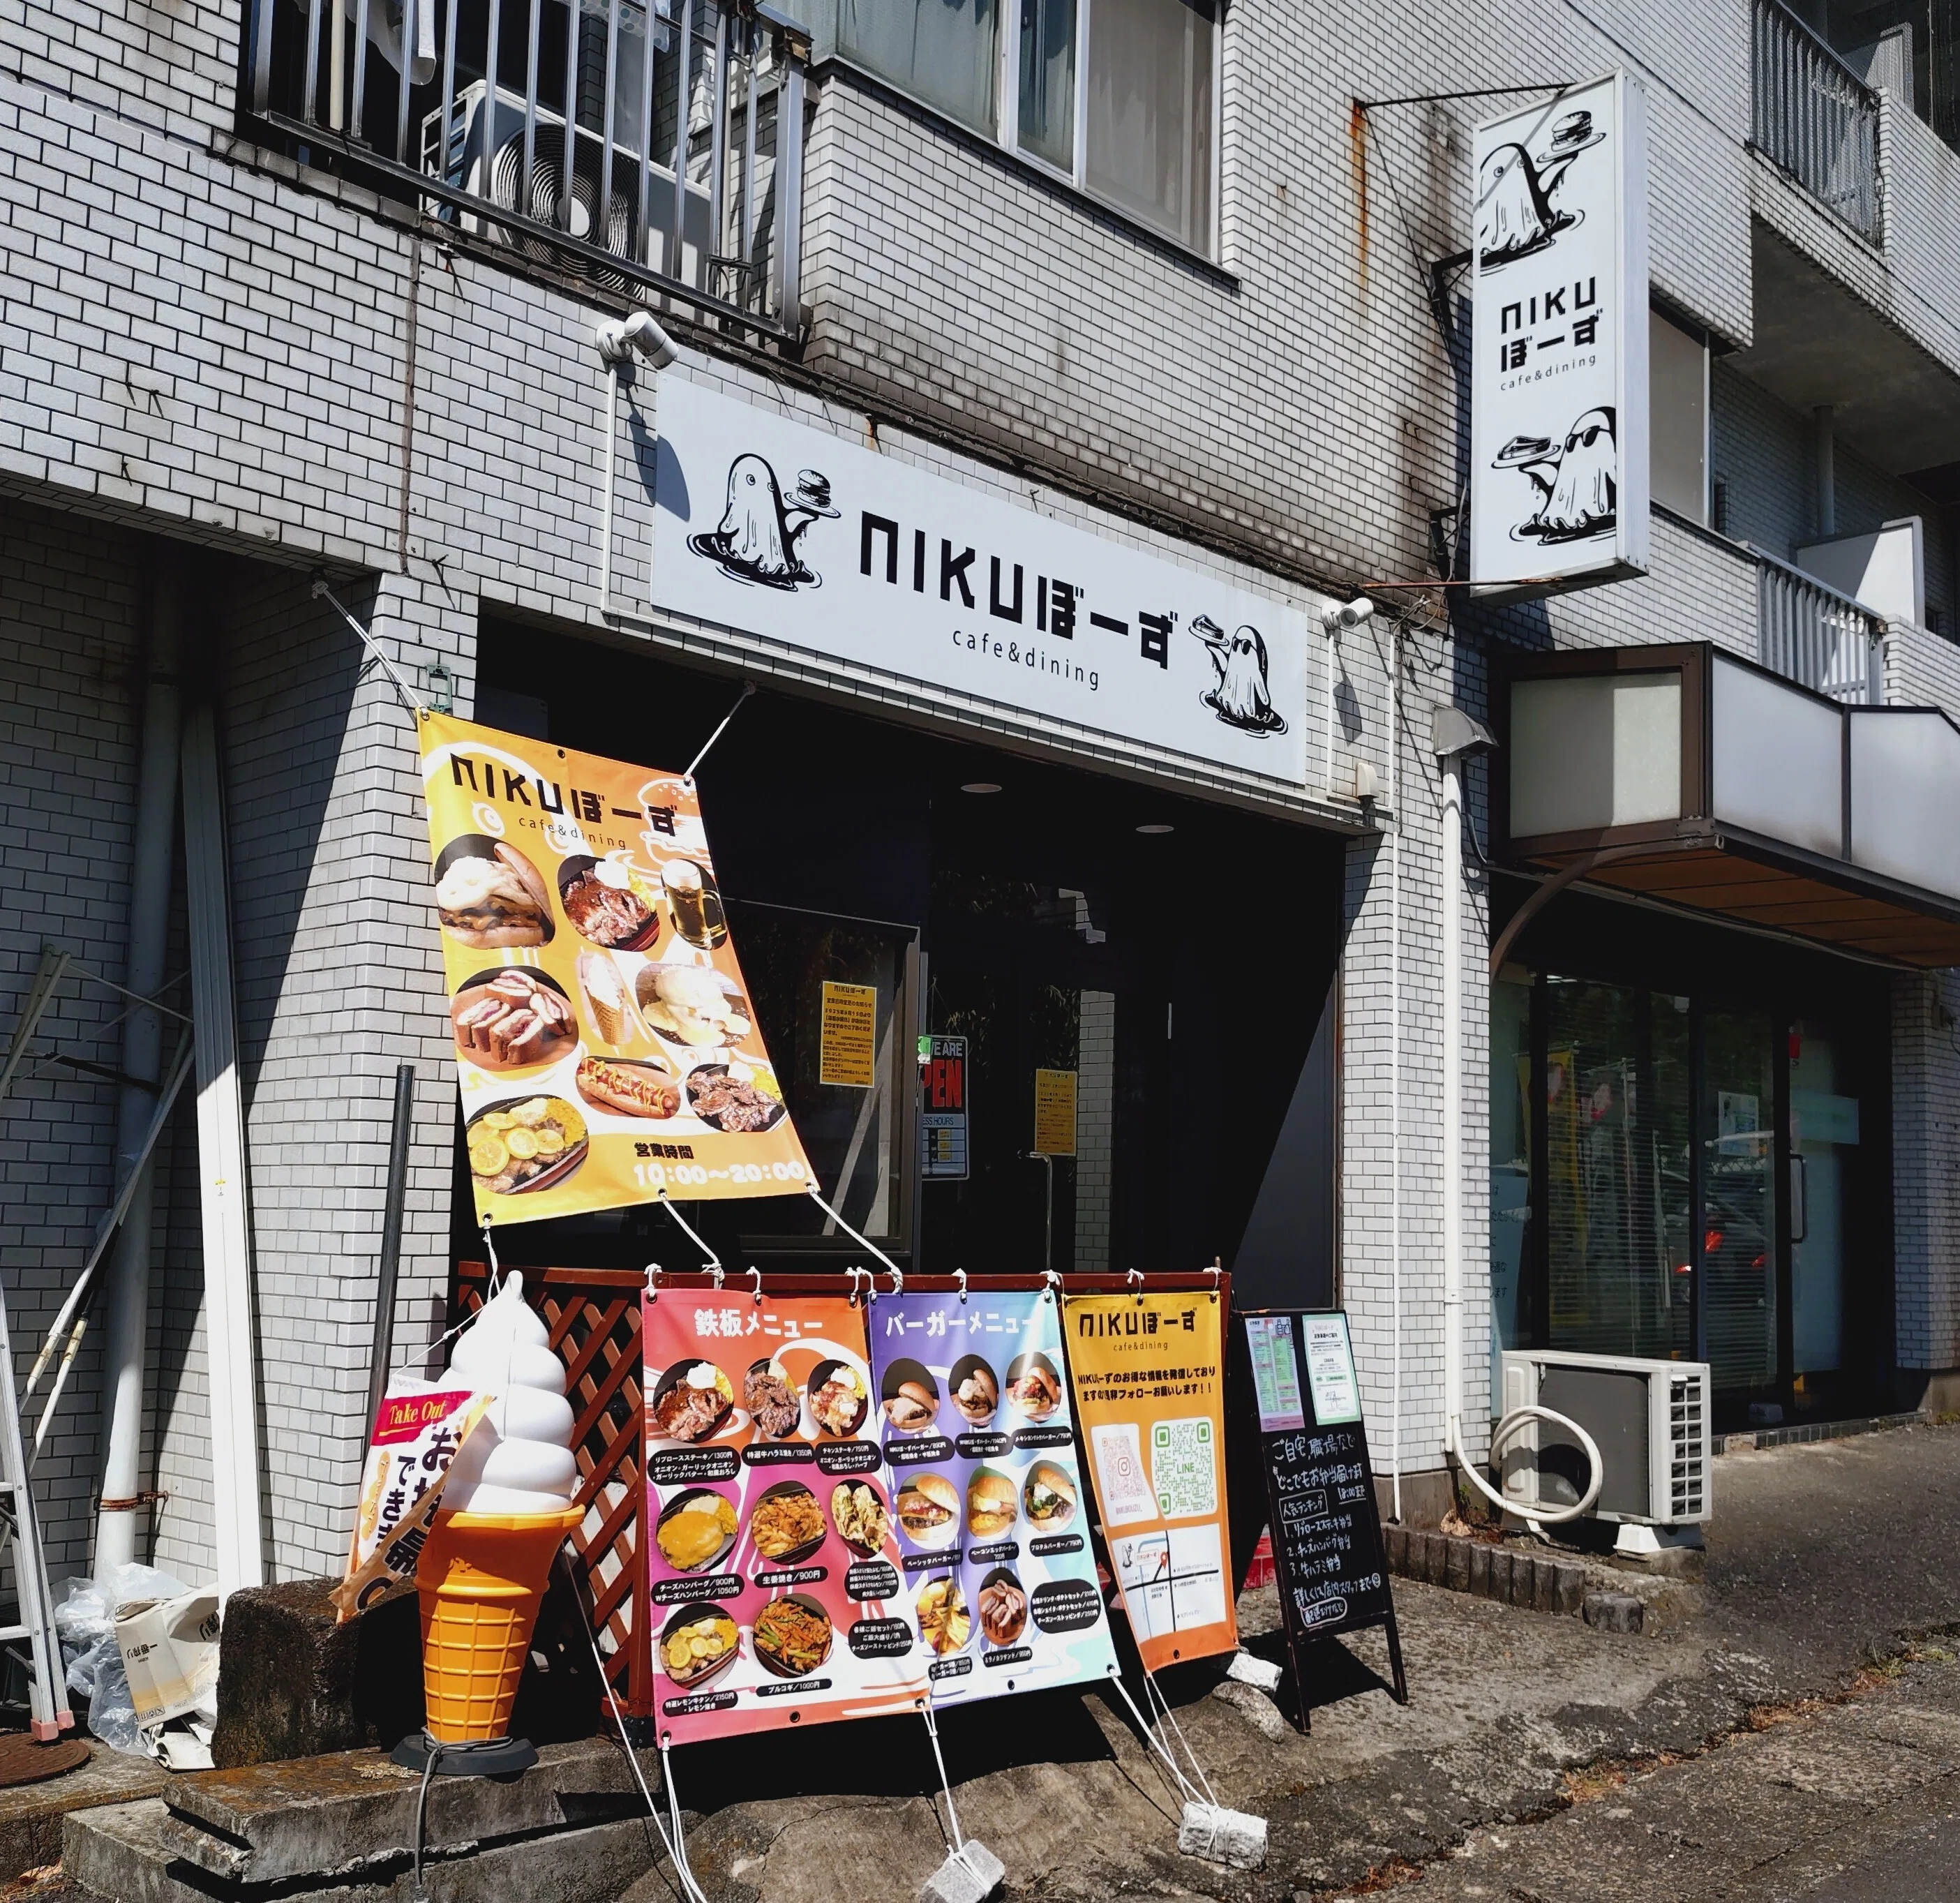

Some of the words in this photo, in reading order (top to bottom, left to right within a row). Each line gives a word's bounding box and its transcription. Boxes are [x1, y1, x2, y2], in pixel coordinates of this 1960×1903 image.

[1501, 277, 1596, 336] NIKU
[1501, 307, 1603, 373] ぼーず
[1500, 355, 1597, 391] cafe&dining
[952, 628, 1100, 692] cafe&dining
[518, 816, 626, 850] cafe&dining
[943, 1042, 962, 1057] ARE
[934, 1117, 954, 1126] HOURS
[634, 1142, 694, 1161] 営業時間
[694, 1308, 823, 1338] 鉄板メニュー
[885, 1309, 1033, 1338] バーガーメニュー
[1113, 1341, 1168, 1352] cafe&dining
[389, 1403, 418, 1426] Take
[421, 1401, 447, 1421] Out
[1177, 1463, 1195, 1475] LINE
